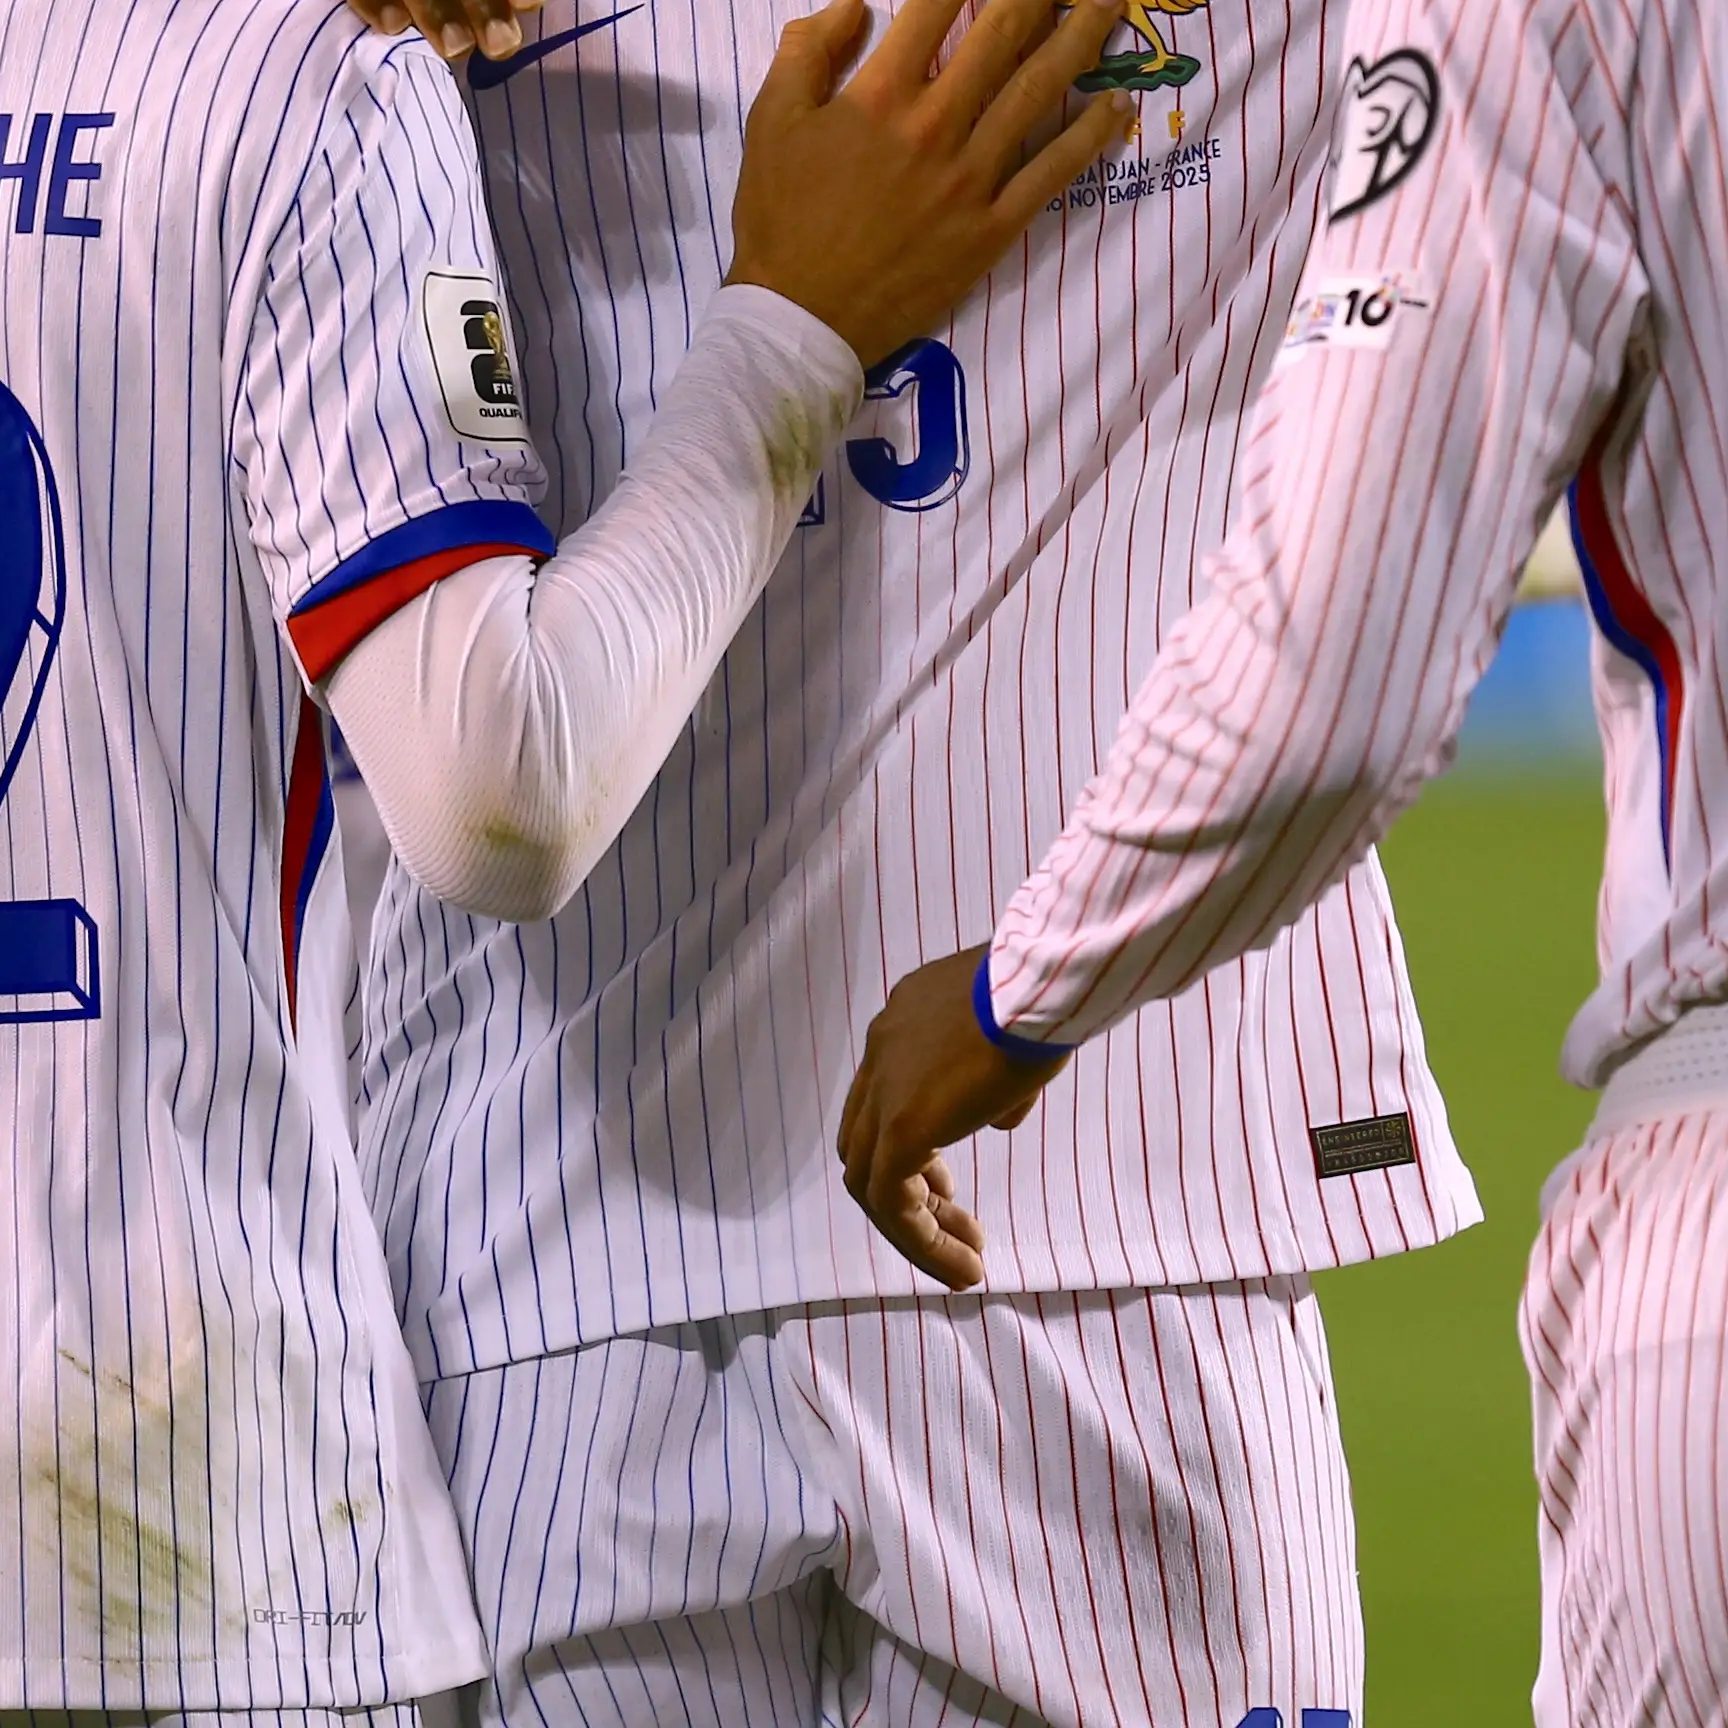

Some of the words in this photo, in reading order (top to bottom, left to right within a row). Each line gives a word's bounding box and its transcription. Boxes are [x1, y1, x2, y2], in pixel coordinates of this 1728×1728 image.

[1165, 138, 1221, 170] FRANCE
[1069, 176, 1155, 209] NOVEMBRE
[1161, 163, 1211, 192] 2025
[492, 382, 517, 395] FIF
